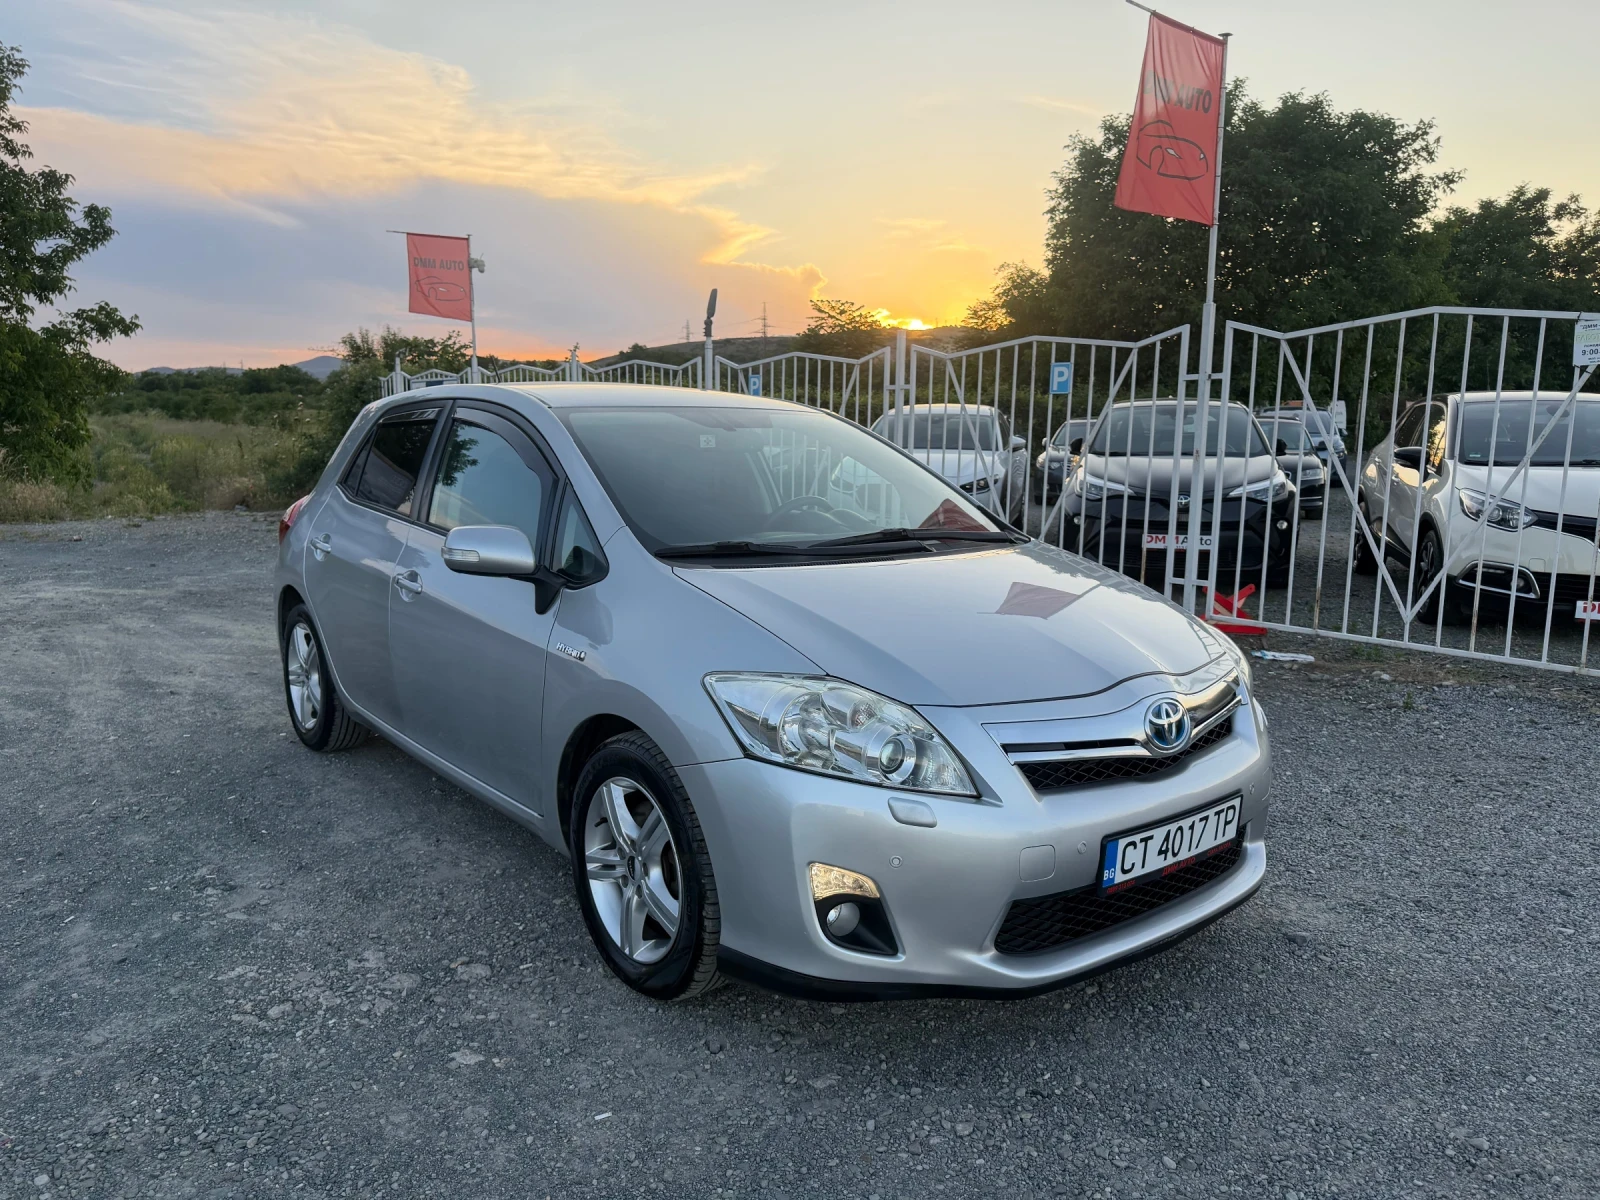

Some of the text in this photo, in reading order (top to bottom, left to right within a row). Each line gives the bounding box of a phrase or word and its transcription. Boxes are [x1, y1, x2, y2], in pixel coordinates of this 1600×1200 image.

[1174, 84, 1212, 114] AUTO
[413, 257, 465, 271] DMM AUTO
[750, 377, 760, 396] P
[1052, 366, 1069, 391] P
[1120, 804, 1237, 875] CT 4017 TP
[1103, 868, 1115, 881] BG
